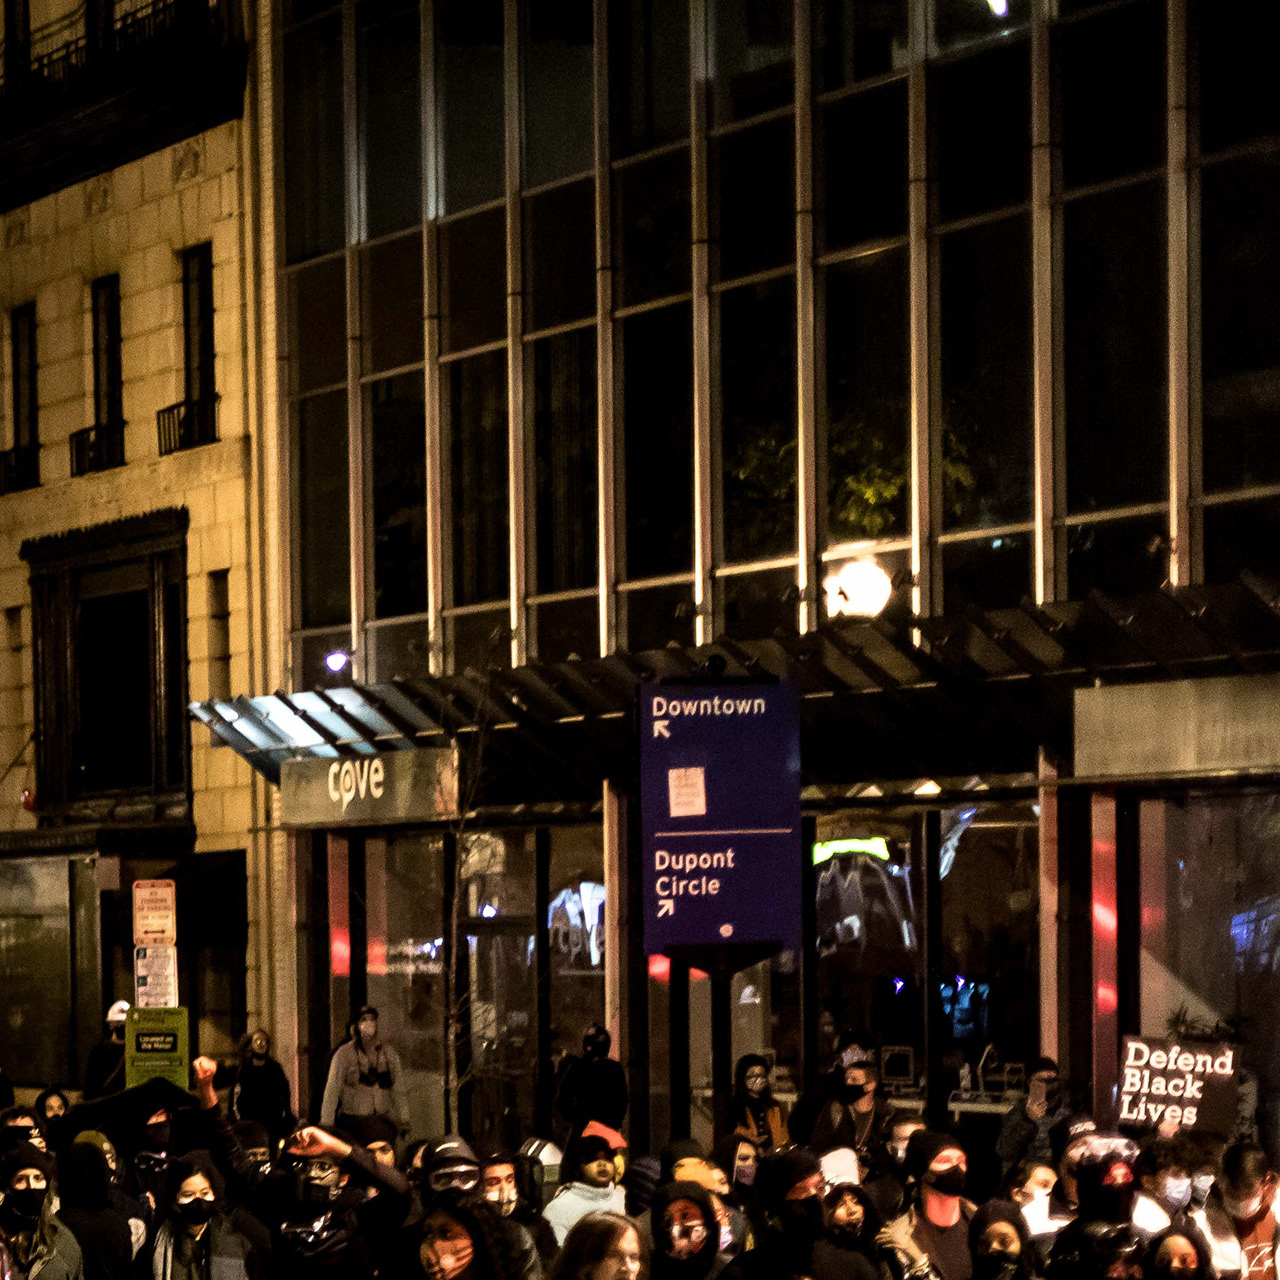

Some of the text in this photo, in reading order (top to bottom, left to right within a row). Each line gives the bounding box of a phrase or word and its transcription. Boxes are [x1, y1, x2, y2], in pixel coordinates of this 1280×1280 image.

[652, 695, 766, 717] Downtown
[328, 758, 385, 814] cove
[654, 848, 735, 874] Dupont
[655, 876, 720, 897] Circle
[1125, 1041, 1234, 1075] Defend
[1122, 1066, 1204, 1099] Black
[1119, 1094, 1198, 1125] Lives
